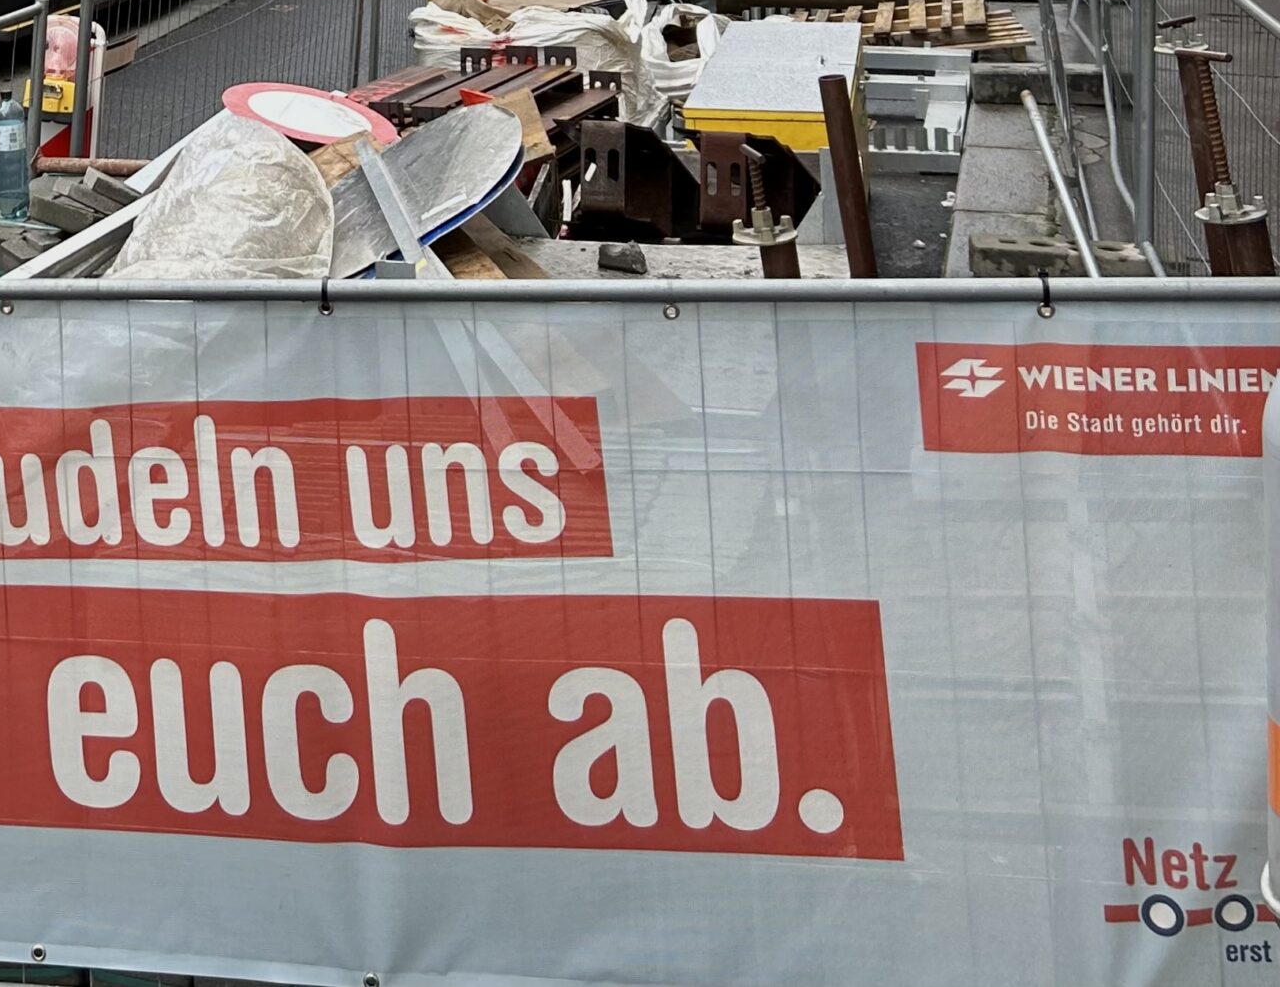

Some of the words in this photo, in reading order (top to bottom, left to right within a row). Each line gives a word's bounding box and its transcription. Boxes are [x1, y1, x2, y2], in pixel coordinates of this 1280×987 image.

[1018, 365, 1158, 392] WIENER
[1026, 411, 1058, 430] Die
[1067, 412, 1124, 434] Stadt
[1132, 414, 1202, 437] gehört
[1210, 414, 1247, 435] dir.
[346, 442, 566, 548] uns
[47, 618, 473, 826] euch
[548, 618, 844, 834] ab.
[1122, 837, 1239, 891] Netz
[1225, 940, 1273, 963] erst
